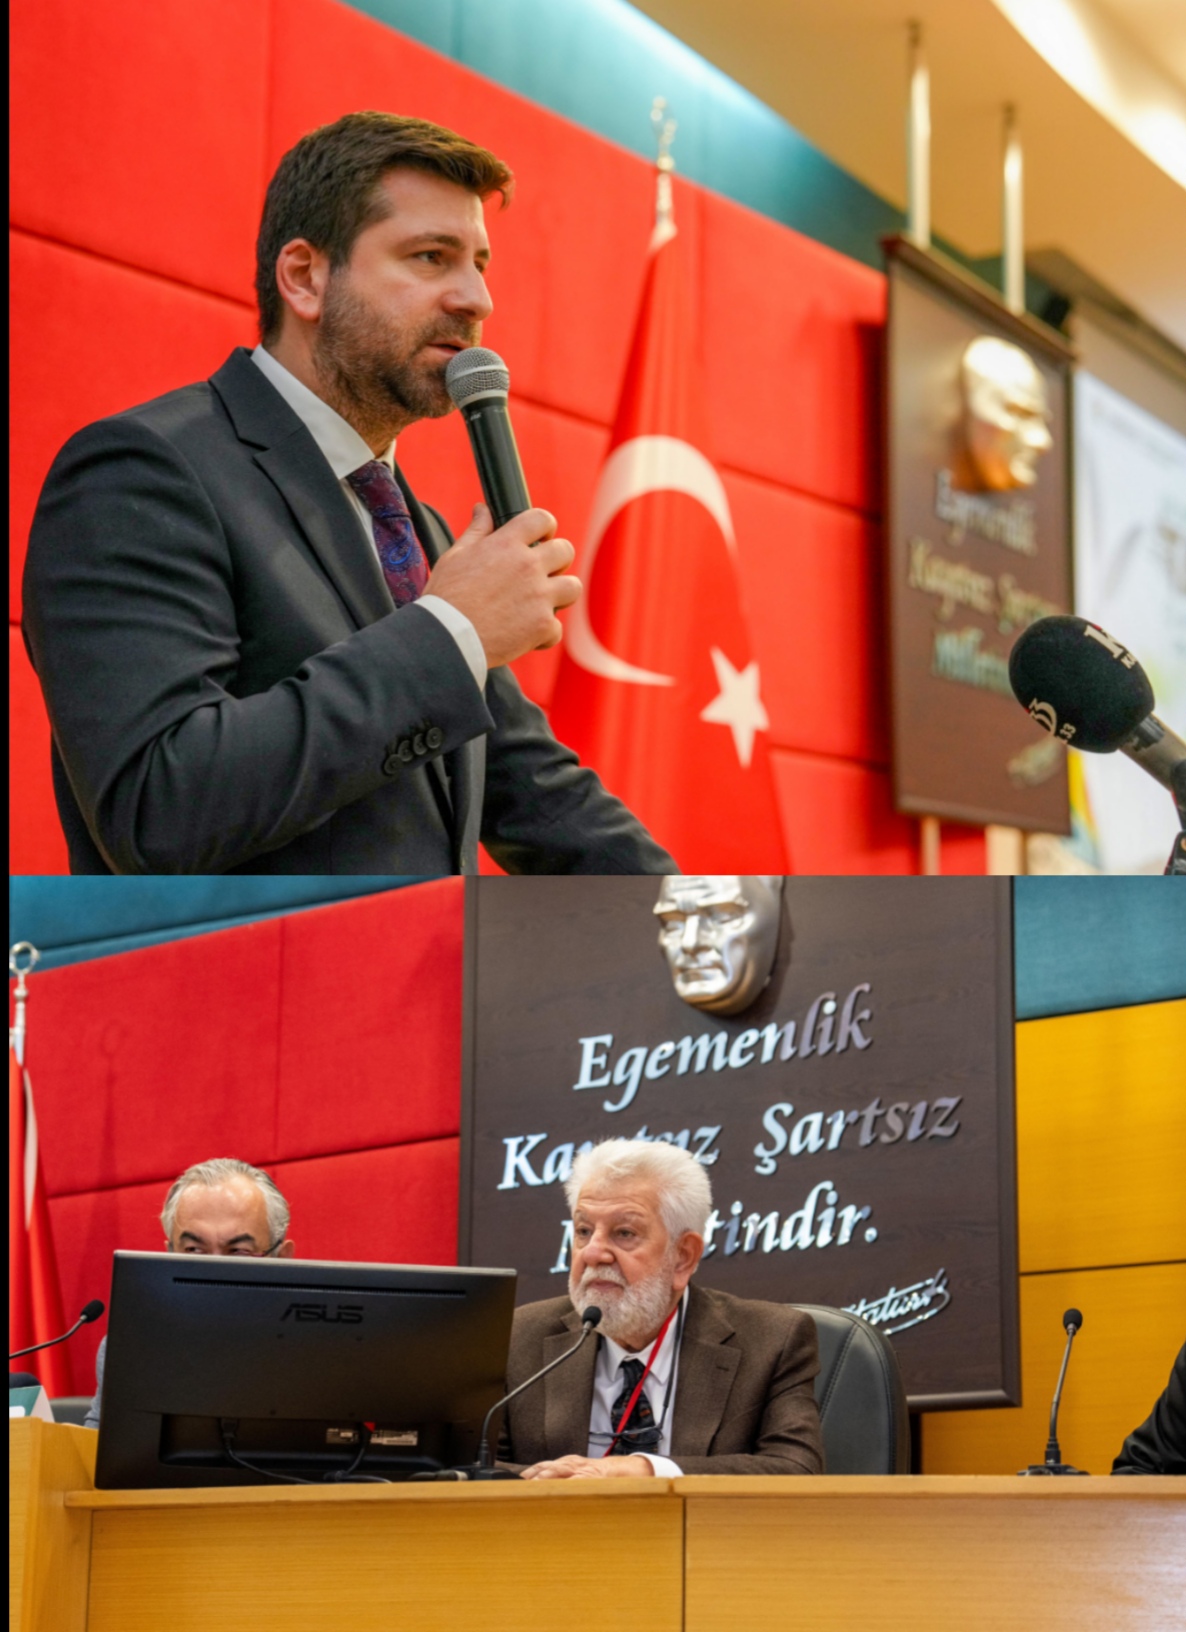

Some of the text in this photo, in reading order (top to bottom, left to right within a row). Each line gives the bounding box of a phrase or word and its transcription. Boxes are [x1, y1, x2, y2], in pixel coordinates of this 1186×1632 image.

[572, 983, 873, 1113] Egemenlik
[753, 1095, 964, 1175] Şartsız
[281, 1303, 364, 1324] ASUS
